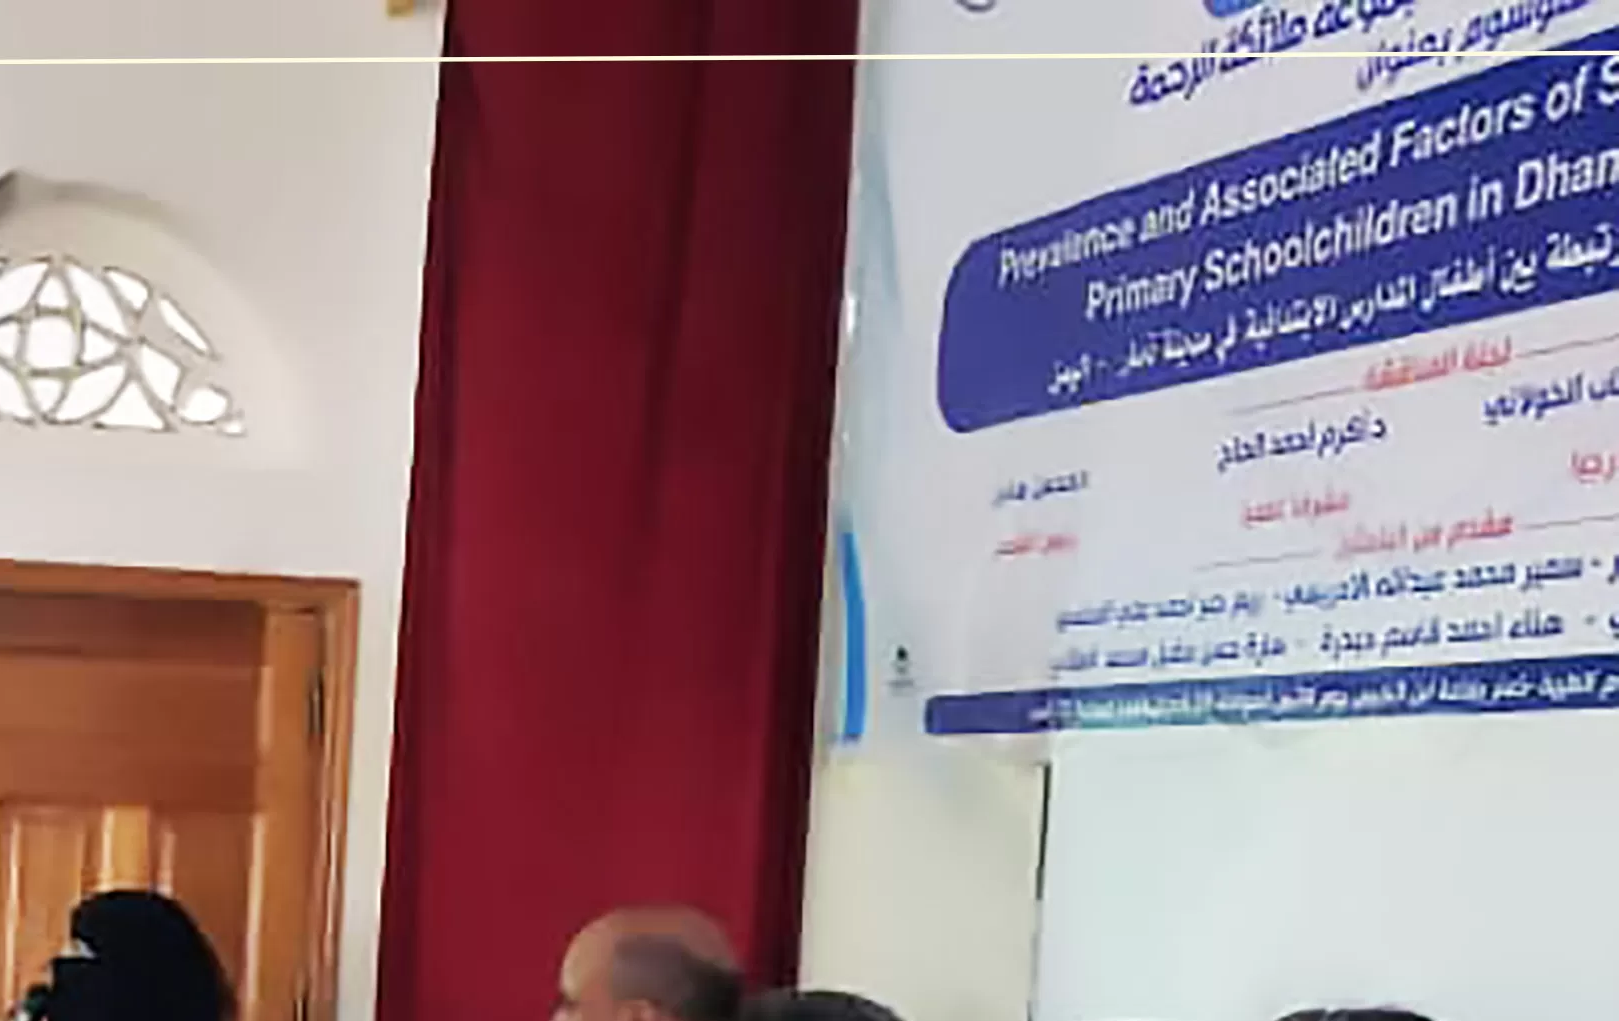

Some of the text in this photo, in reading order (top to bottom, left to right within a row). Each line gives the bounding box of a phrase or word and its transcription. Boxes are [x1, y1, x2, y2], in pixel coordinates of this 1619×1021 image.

[997, 216, 1138, 290] Prevalence
[1139, 186, 1197, 243] and
[1199, 129, 1381, 228] Associated
[1389, 92, 1538, 168] Factors
[1544, 61, 1591, 122] of
[1085, 262, 1197, 321] Primary
[1203, 192, 1458, 293] Schoolchildren
[1466, 173, 1504, 223] in
